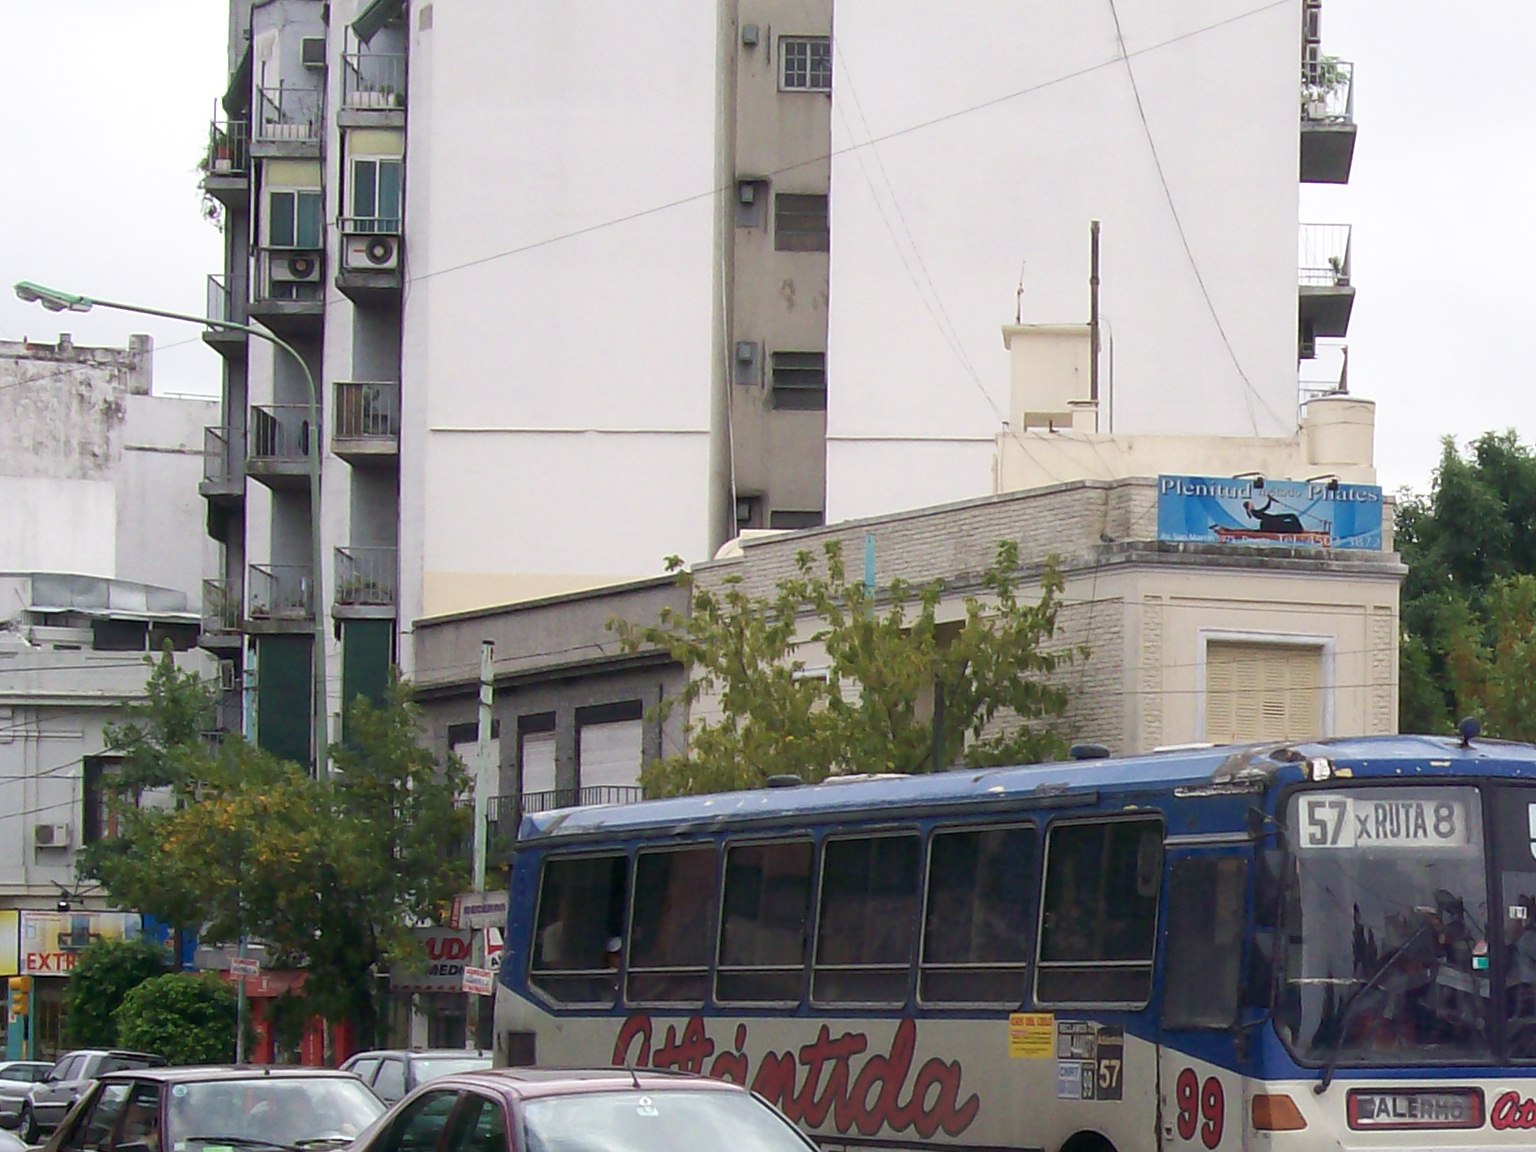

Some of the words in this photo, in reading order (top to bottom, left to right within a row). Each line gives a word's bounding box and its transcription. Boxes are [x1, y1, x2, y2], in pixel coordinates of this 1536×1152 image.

[1161, 478, 1252, 499] Plenitud
[1306, 484, 1379, 503] Pilates
[1308, 800, 1347, 845] 57
[1373, 803, 1428, 839] RUTA
[1433, 802, 1456, 839] 8
[1099, 1060, 1121, 1088] 57
[1176, 1067, 1225, 1149] 99
